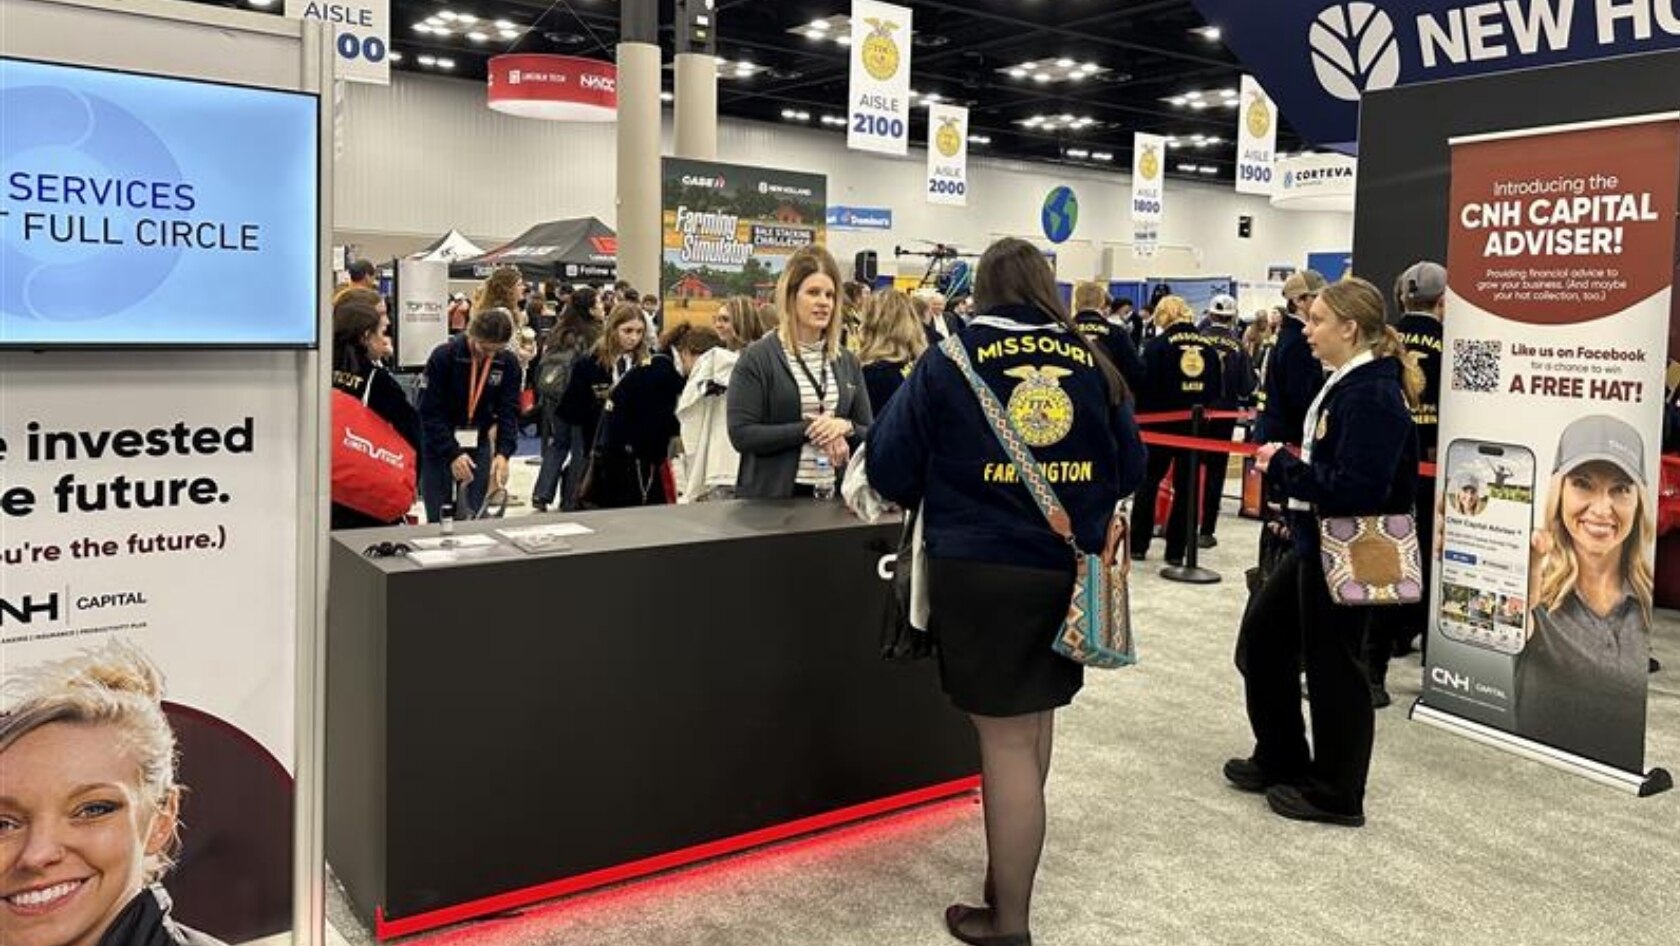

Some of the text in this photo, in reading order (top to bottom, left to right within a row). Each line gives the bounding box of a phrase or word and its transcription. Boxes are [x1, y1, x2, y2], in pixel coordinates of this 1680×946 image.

[304, 2, 373, 27] AISLE
[1416, 0, 1574, 68] NEW
[859, 94, 899, 113] AISLE
[853, 113, 904, 139] 2100
[682, 175, 714, 187] CASE
[935, 167, 962, 177] AISLE
[1239, 163, 1272, 183] 1900
[1296, 167, 1352, 181] CORTEVA
[8, 172, 196, 212] SERVICES
[929, 178, 964, 196] 2000
[1493, 174, 1618, 196] Introducing the
[1134, 199, 1160, 214] 1800
[1460, 193, 1659, 228] CNH CAPITAL
[23, 213, 260, 251] FULL CIRCLE
[675, 206, 738, 241] Farming
[681, 235, 753, 265] Simulator
[1483, 227, 1623, 257] ADVISER!
[1476, 281, 1498, 291] grow
[1500, 282, 1521, 290] your
[1565, 279, 1589, 289] (And
[1590, 279, 1627, 291] maybe
[1486, 268, 1619, 280] Providing financial advice to
[1493, 292, 1513, 301] your
[1532, 290, 1580, 302] collection,
[977, 335, 1095, 367] MISSOURI
[1511, 343, 1646, 362] Like us on Facebook
[1531, 361, 1543, 369] for
[1553, 361, 1589, 373] chance
[1590, 365, 1603, 373] to
[1508, 374, 1643, 403] A FREE HAT!
[27, 417, 254, 461] invested
[983, 461, 1093, 484] FARNGTON
[54, 474, 230, 513] future.
[70, 536, 119, 557] the
[127, 524, 227, 554] future.)
[76, 592, 147, 611] CAPITAL
[1431, 666, 1470, 692] CNH
